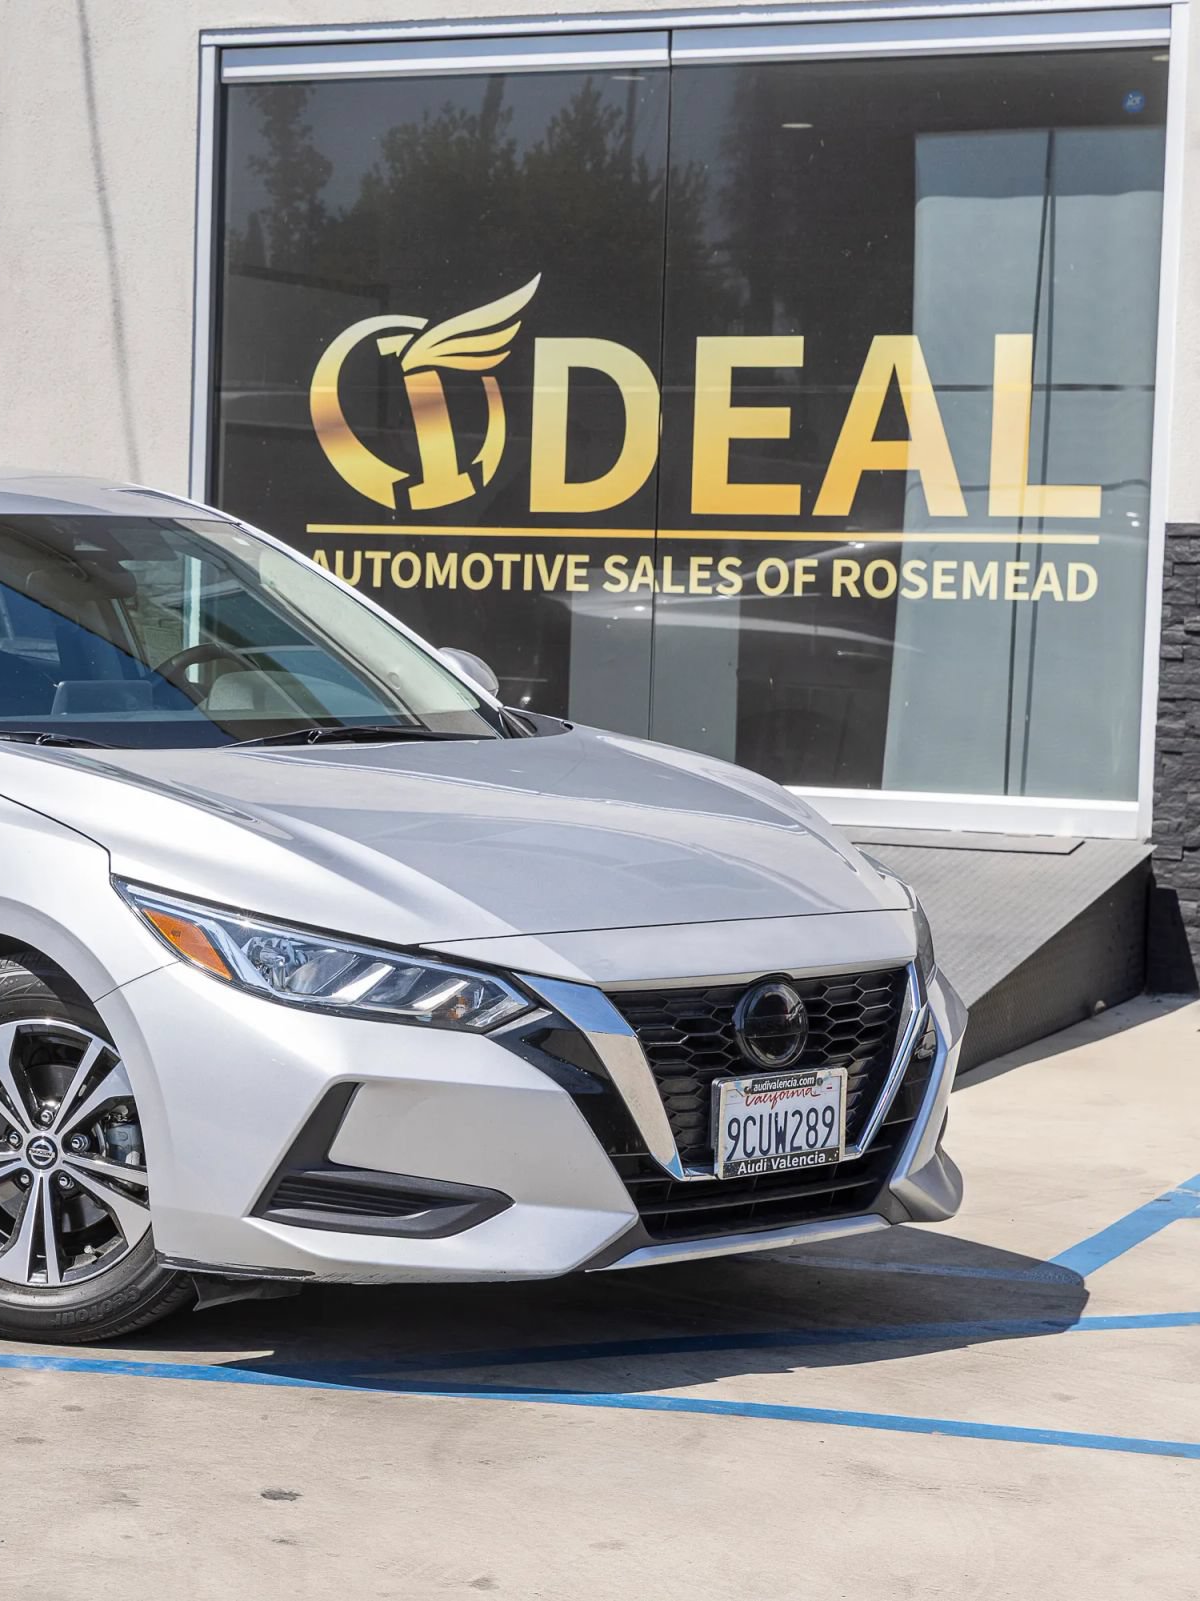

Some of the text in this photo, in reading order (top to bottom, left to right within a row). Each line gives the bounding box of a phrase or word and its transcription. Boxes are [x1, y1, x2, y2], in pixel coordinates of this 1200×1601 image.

[603, 555, 743, 596] SALES
[756, 557, 819, 598] OF
[831, 559, 1099, 602] ROSEMEAD
[753, 1075, 815, 1092] audivalencia.com
[726, 1105, 835, 1162] 9CUW289
[737, 1151, 826, 1175] Audi Valencia
